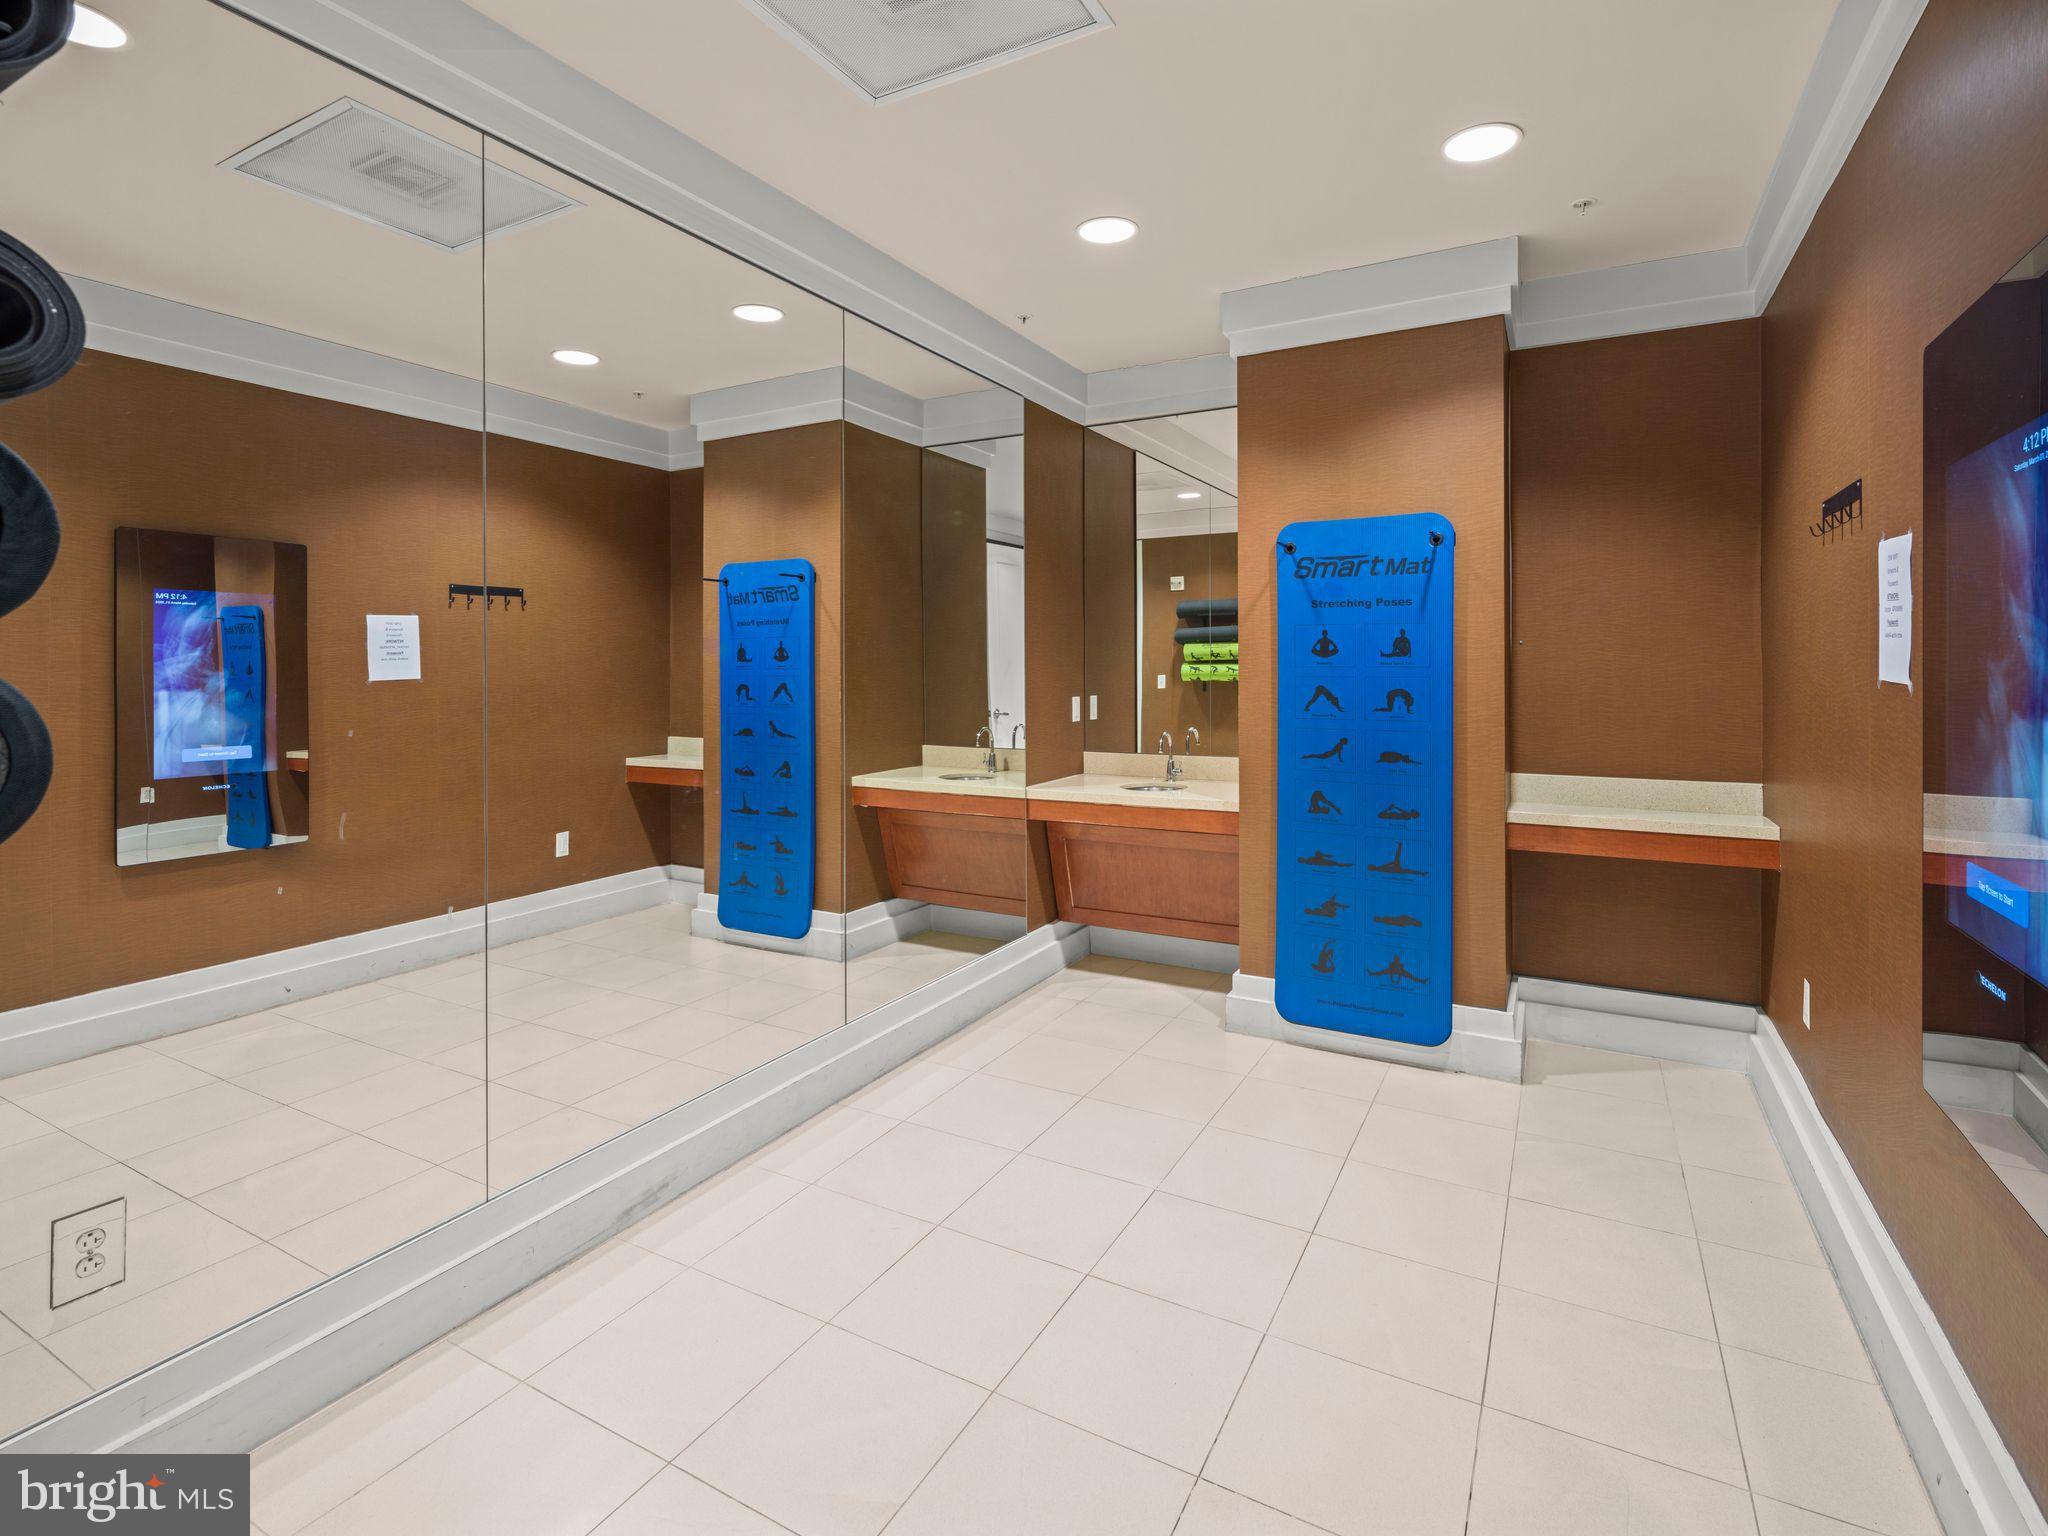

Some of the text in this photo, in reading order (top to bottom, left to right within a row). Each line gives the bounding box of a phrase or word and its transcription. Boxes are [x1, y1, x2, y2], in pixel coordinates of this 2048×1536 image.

[2023, 426, 2048, 452] 4:12 P
[1294, 555, 1433, 579] Smart Mat
[1311, 597, 1413, 610] Stretching Poses
[1981, 975, 2007, 1001] ECHELON
